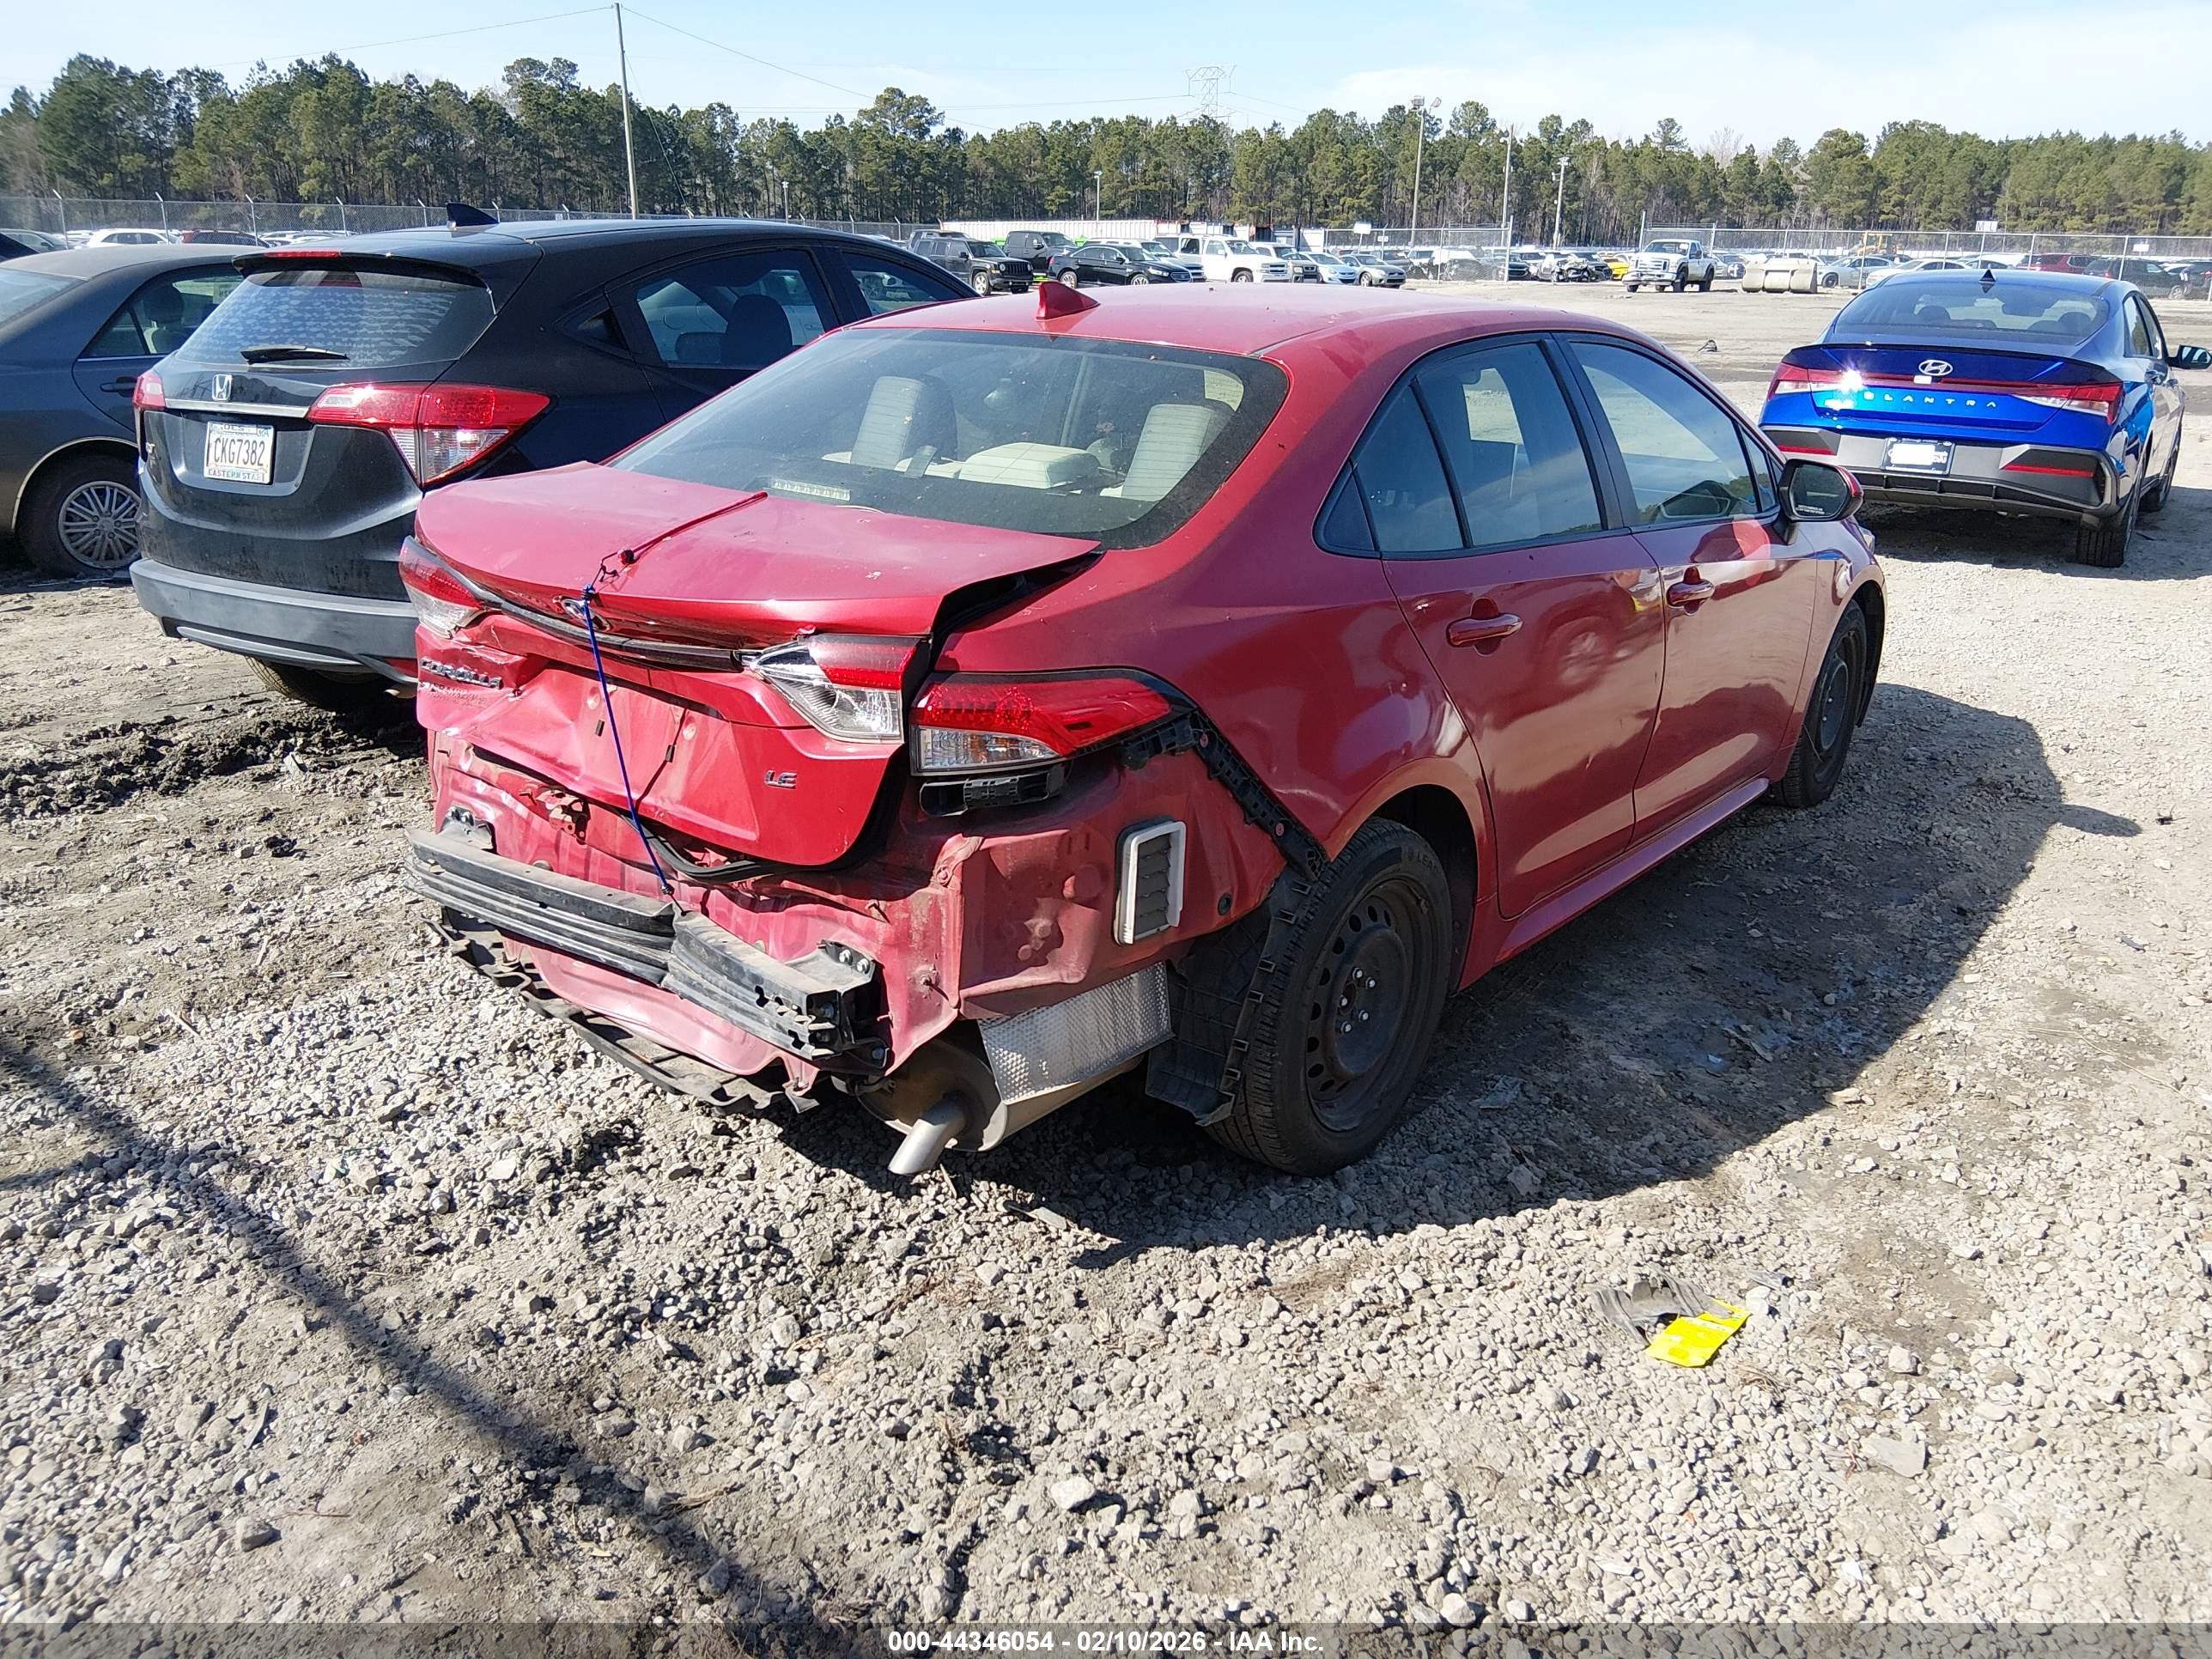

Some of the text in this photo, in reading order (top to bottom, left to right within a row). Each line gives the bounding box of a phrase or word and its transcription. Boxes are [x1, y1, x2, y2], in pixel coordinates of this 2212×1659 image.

[214, 437, 265, 466] CKG7382
[208, 468, 241, 478] EASTERN
[420, 657, 503, 690] COROLLA
[764, 769, 798, 789] LE
